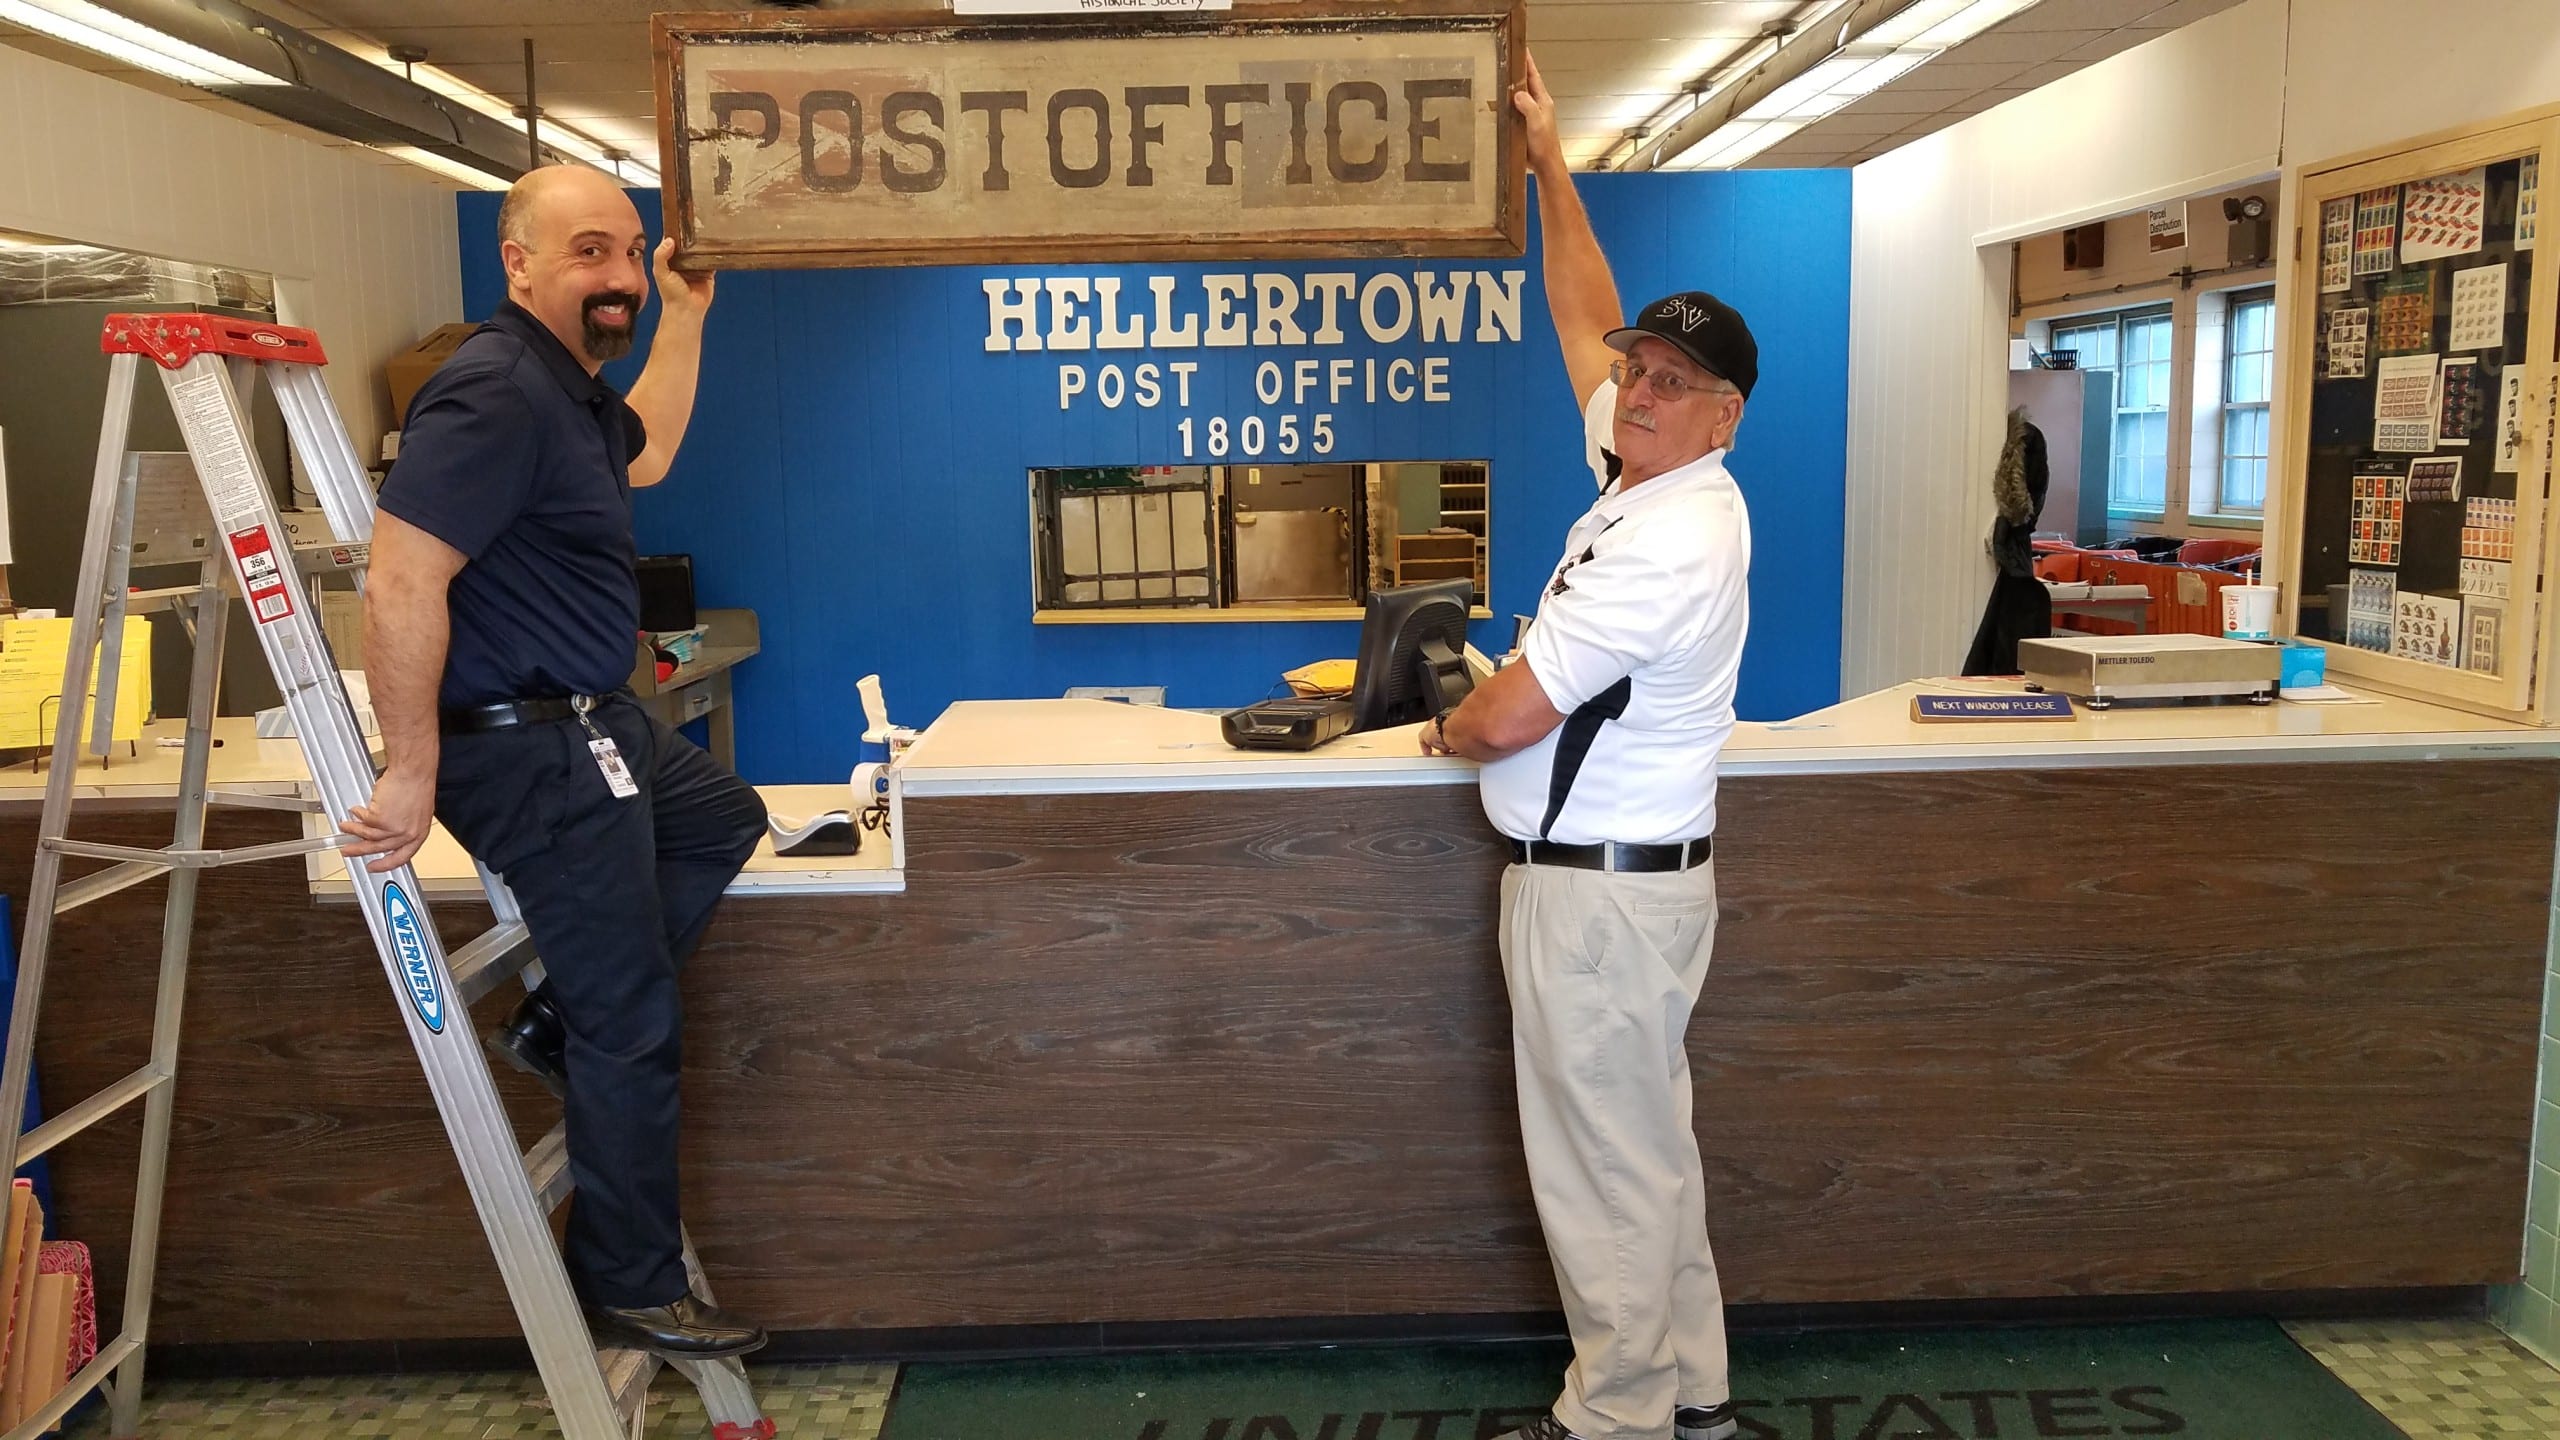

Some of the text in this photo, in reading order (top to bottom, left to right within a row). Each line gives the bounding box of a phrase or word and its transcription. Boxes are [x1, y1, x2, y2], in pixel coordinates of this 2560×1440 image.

[2149, 207, 2167, 221] Parcel
[2149, 217, 2182, 234] Distribution
[982, 270, 1526, 351] HELLERTOWN
[1060, 357, 1451, 409] POST OFFICE
[1178, 413, 1335, 457] 18055
[250, 557, 266, 569] 356
[2098, 656, 2155, 665] METTLER TOLEDO
[1932, 701, 2057, 710] NEXT WINDOW PLEASE
[393, 911, 436, 1004] WERNER
[1728, 1385, 2187, 1440] STATES
